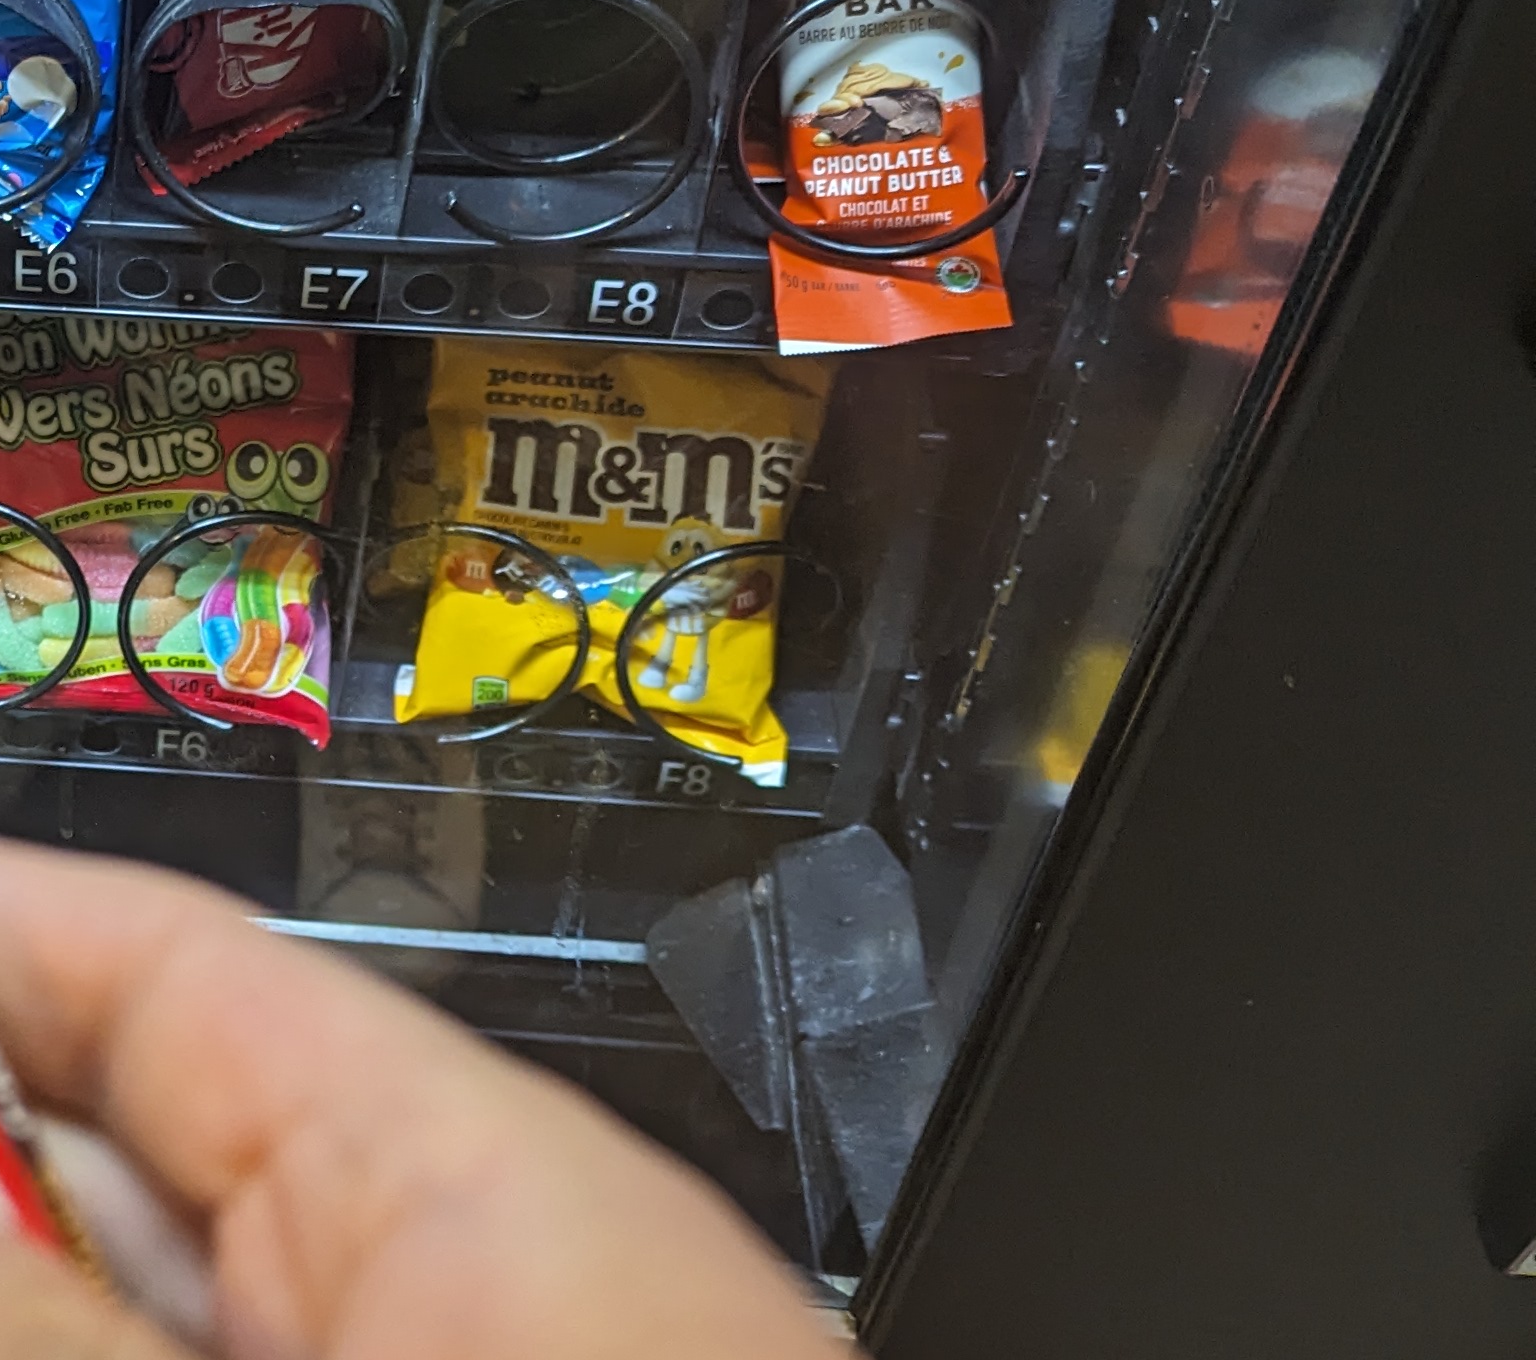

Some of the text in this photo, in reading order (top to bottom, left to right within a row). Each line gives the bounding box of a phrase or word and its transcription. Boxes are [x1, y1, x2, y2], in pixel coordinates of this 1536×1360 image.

[798, 16, 926, 45] BARRE AU BEURRE DE
[812, 146, 935, 177] CHOCOLATE
[804, 166, 964, 199] PEANUT BUTTER
[839, 194, 931, 218] CHOCOLAT ET
[14, 250, 78, 295] E6
[300, 267, 369, 312] E7
[587, 280, 659, 326] E8
[128, 354, 295, 425] Néons
[486, 366, 615, 392] peanut
[484, 390, 646, 418] arachide
[87, 425, 218, 488] Surs
[56, 508, 90, 529] Free
[103, 499, 133, 514] Fat
[136, 496, 174, 512] Free
[167, 655, 207, 670] Gras
[168, 677, 198, 695] 120
[156, 731, 208, 763] F6
[656, 762, 712, 795] F8
